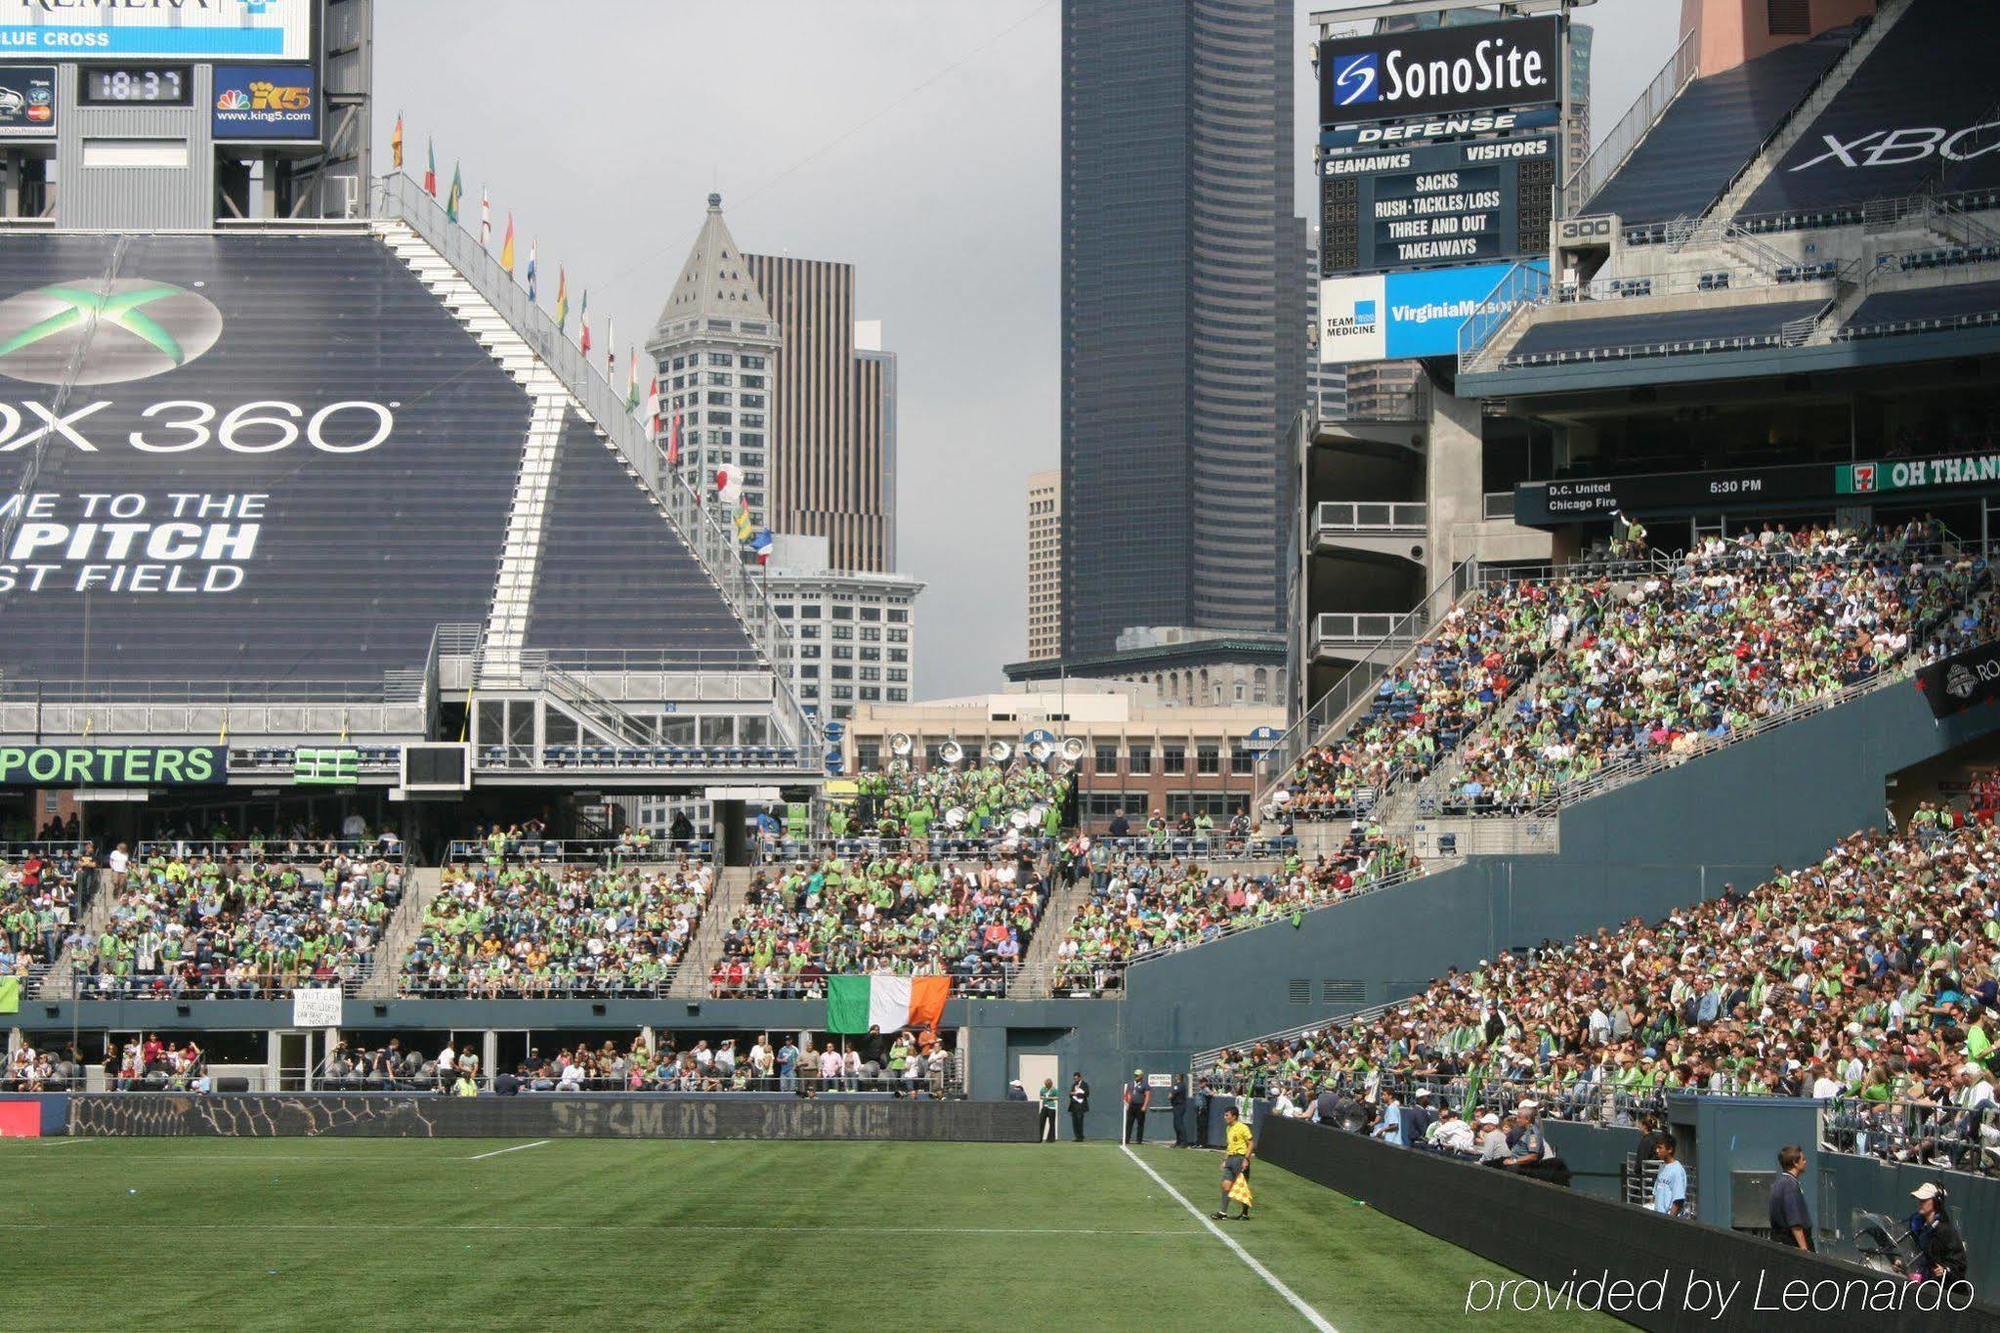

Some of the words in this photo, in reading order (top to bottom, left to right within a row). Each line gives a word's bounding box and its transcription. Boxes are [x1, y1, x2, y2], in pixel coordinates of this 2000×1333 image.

[44, 32, 110, 46] CROSS
[1386, 38, 1542, 100] SonoSite
[102, 71, 181, 100] 18:37
[217, 111, 312, 122] www.king5.com
[1358, 113, 1517, 143] DEFENSE
[1466, 140, 1547, 161] VISITORS
[1325, 154, 1411, 176] SEAHAWKS
[1416, 172, 1459, 192] SACKS
[1389, 219, 1429, 239] THREE
[1431, 217, 1458, 235] AND
[1462, 214, 1487, 232] OUT
[1563, 220, 1610, 238] 300
[1398, 238, 1476, 261] TAKEAWAYS
[1327, 317, 1354, 327] TEAM
[1327, 325, 1376, 337] MEDICINE
[0, 400, 113, 451] X
[129, 400, 394, 453] 360
[1892, 461, 1926, 487] OH
[1931, 455, 2000, 484] THAN
[1550, 485, 1572, 496] D.C.
[1576, 483, 1611, 494] United
[1710, 481, 1738, 494] 5:30
[1742, 480, 1762, 491] PM
[79, 493, 146, 518] TO
[167, 494, 270, 518] THE
[1550, 499, 1593, 511] Chicago
[1596, 498, 1617, 508] Fire
[10, 523, 260, 560] PITCH
[75, 565, 244, 592] FIELD
[0, 748, 214, 782] PORTERS
